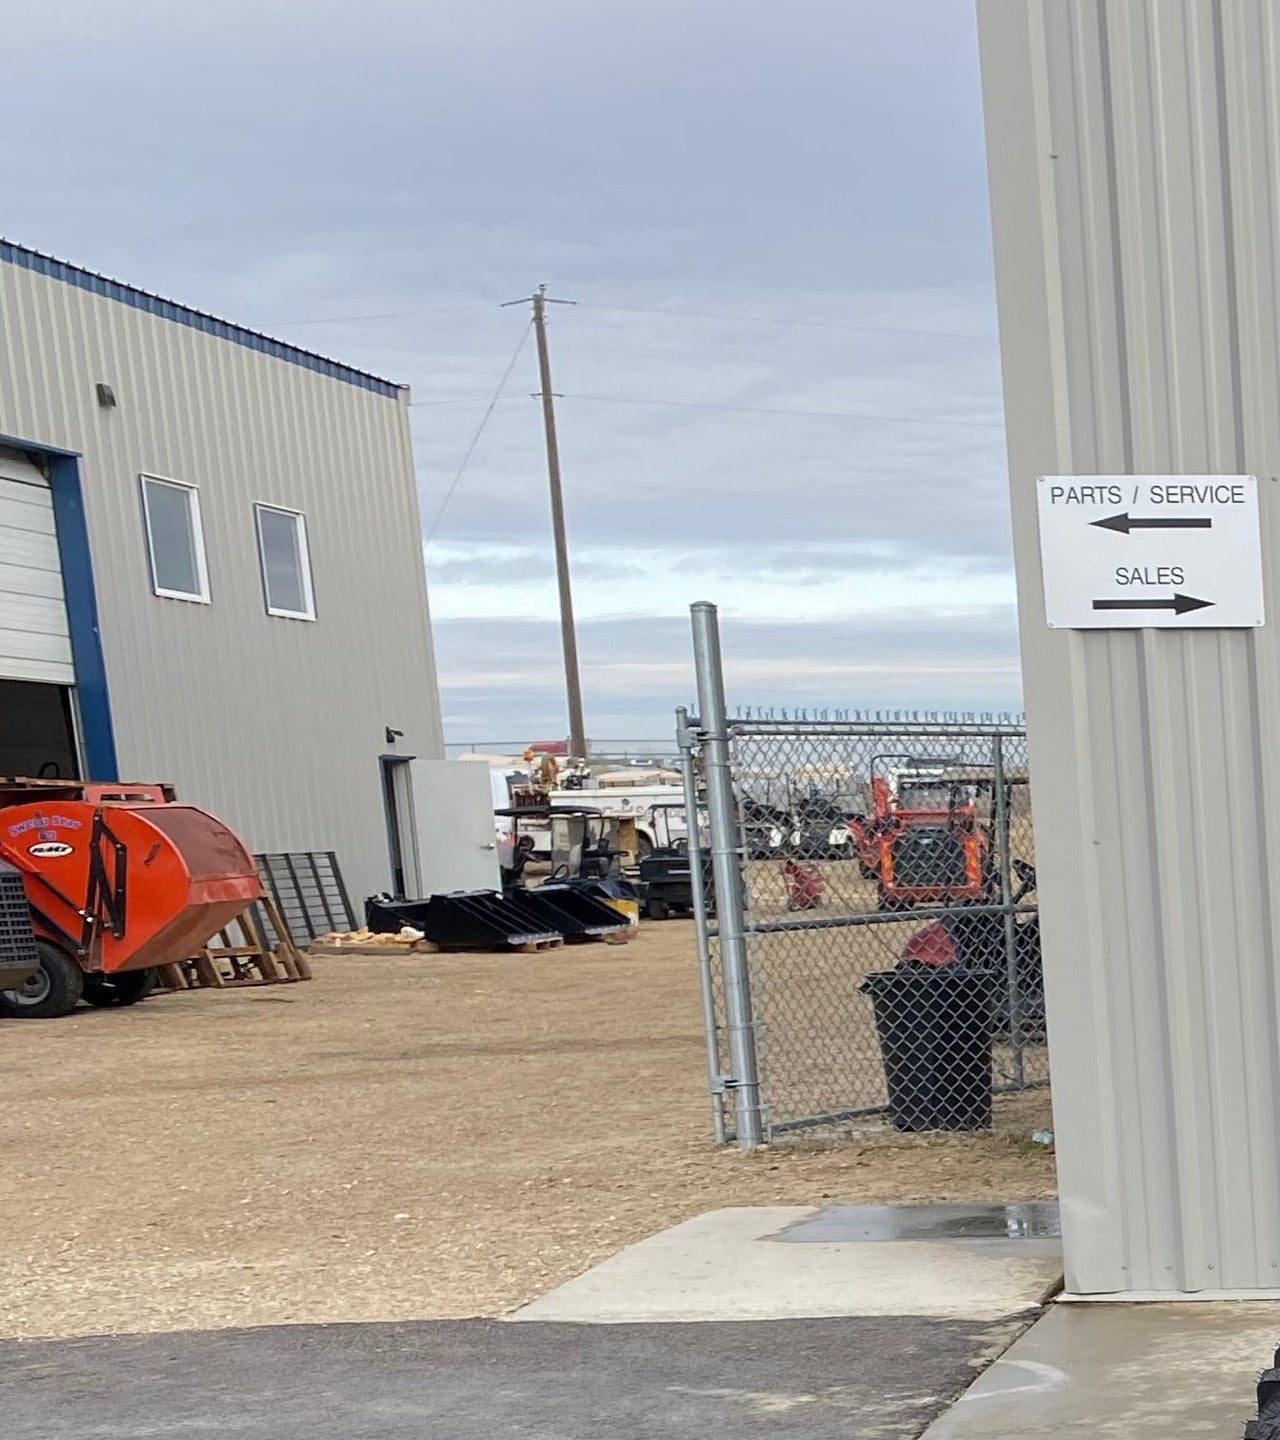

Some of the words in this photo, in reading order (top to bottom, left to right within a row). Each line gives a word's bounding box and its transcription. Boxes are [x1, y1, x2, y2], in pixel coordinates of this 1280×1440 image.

[1050, 486, 1122, 504] PARTS
[1132, 486, 1139, 504] /
[1149, 485, 1245, 504] SERVICE
[1115, 566, 1185, 585] SALES
